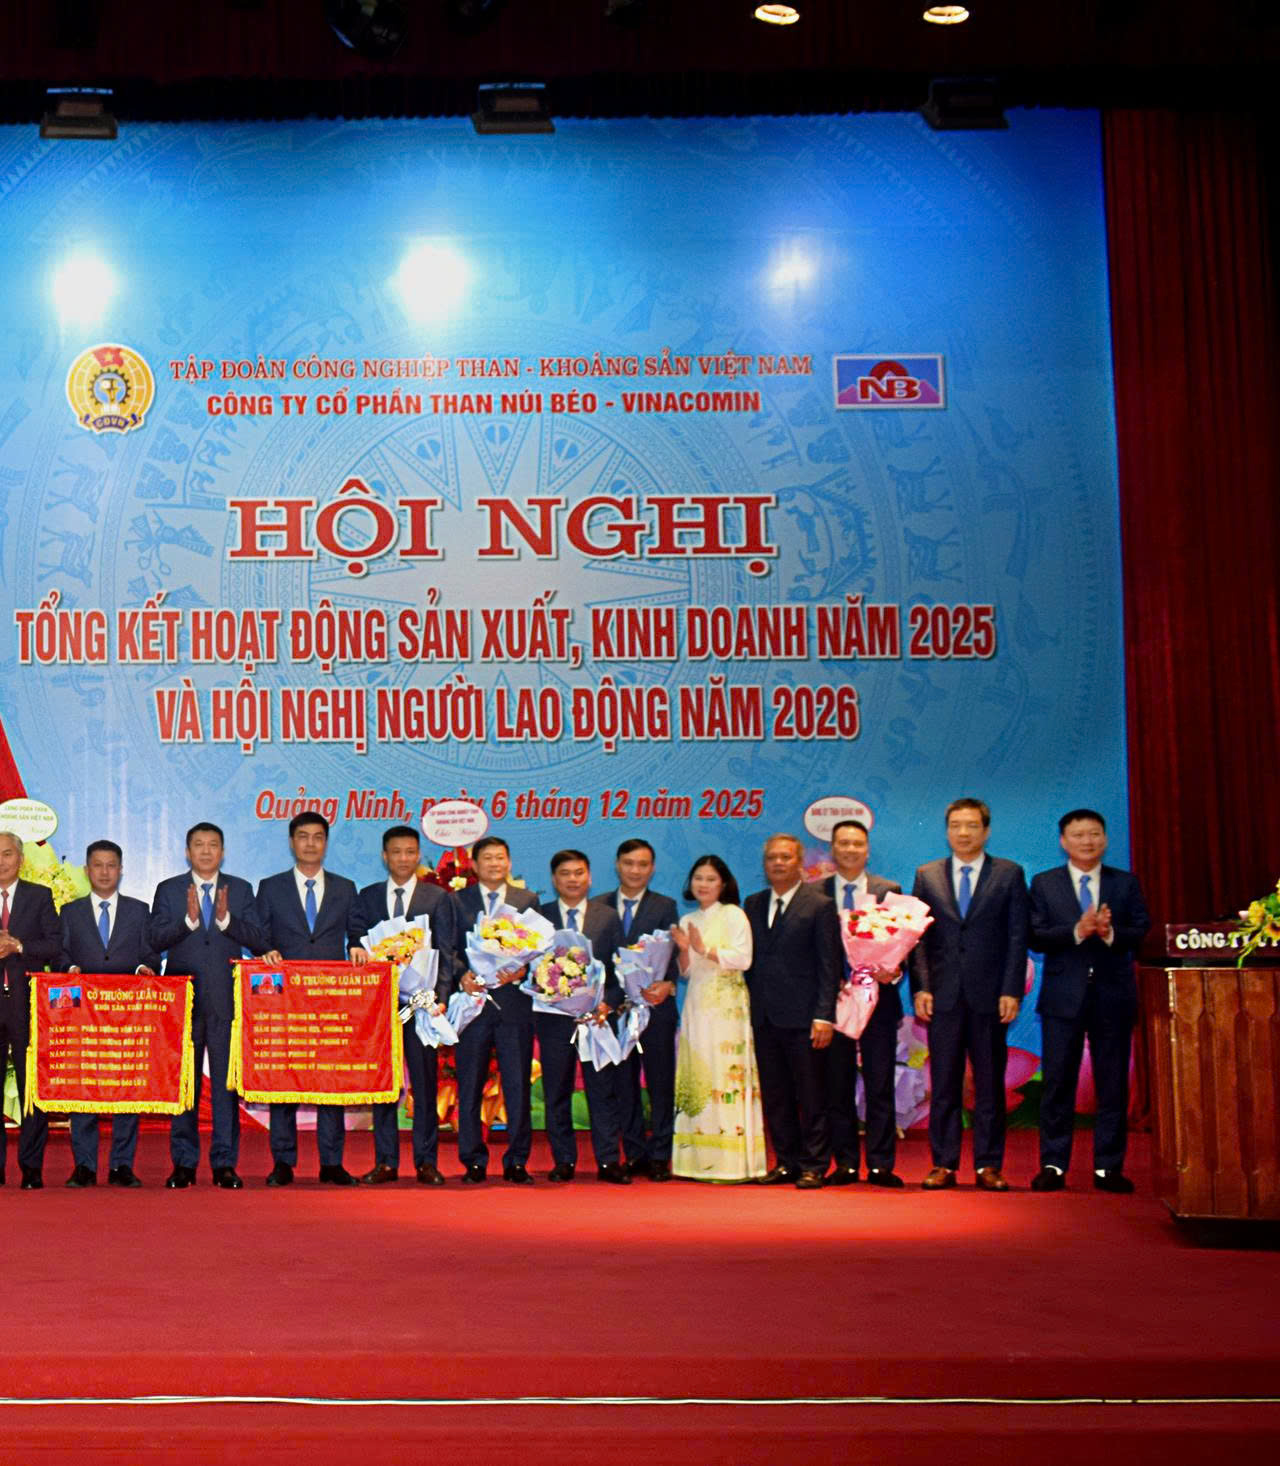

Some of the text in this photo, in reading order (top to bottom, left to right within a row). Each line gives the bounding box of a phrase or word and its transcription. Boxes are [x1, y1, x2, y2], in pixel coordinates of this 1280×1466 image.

[170, 354, 215, 384] TẬP
[221, 354, 286, 380] ĐOÀN
[292, 354, 355, 379] CÔNG
[362, 352, 449, 381] NGHIỆP
[456, 357, 519, 378] THAN
[539, 352, 639, 377] KHOÁNG
[644, 347, 691, 376] SẢN
[697, 350, 751, 380] VIỆT
[757, 355, 812, 376] NAM
[207, 391, 273, 416] CÔNG
[280, 394, 308, 416] TY
[316, 386, 350, 416] CỔ
[356, 387, 421, 415] PHẦN
[429, 394, 493, 415] THAN
[501, 389, 542, 414] NÚI
[551, 389, 597, 414] BÉO
[622, 390, 762, 413] VINACOMIN
[227, 477, 779, 578] HỘI NGHỊ
[15, 587, 995, 673] TỔNG KẾT HOẠT ĐỘNG SẢN XUẤT, KINH DOANH NĂM 2025
[155, 674, 860, 756] VÀ HỘI NGHỊ NGƯỜI LAO ĐỘNG NĂM 2026
[345, 787, 412, 822] Ninh,
[491, 790, 508, 819] 6
[515, 787, 590, 826] tháng
[599, 789, 629, 819] 12
[635, 788, 692, 819] năm
[698, 789, 764, 819] 2025
[1175, 928, 1226, 950] CÔNG
